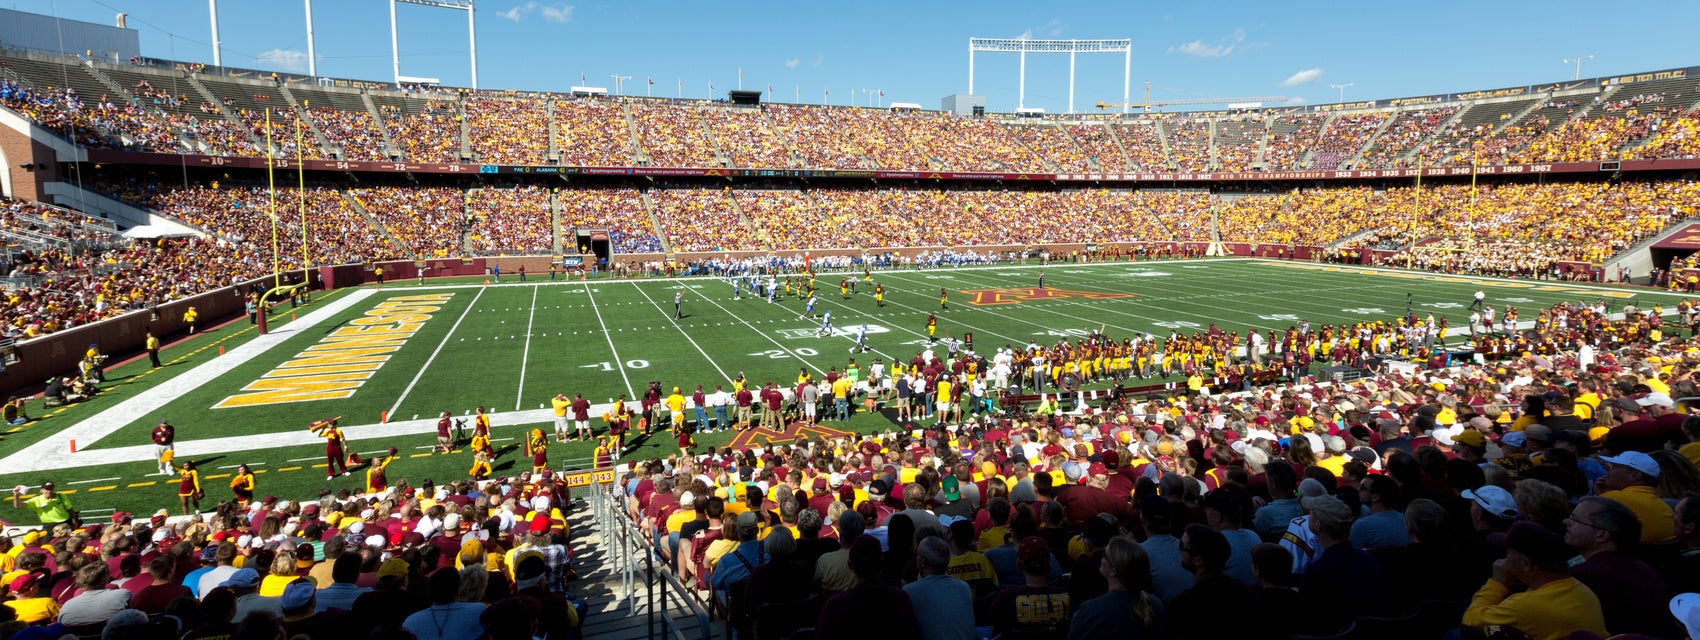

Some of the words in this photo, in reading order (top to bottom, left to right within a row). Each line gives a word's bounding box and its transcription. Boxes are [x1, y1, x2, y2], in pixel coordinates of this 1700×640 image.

[1636, 74, 1653, 82] TEN
[211, 157, 224, 165] 10
[276, 159, 288, 168] 15
[394, 163, 406, 171] 72
[1502, 165, 1523, 173] 1960
[1530, 164, 1552, 172] 1967
[209, 292, 456, 409] MINNESOTA
[763, 347, 819, 359] 20
[599, 359, 650, 372] 10
[568, 476, 584, 484] 144
[596, 472, 612, 481] 143
[946, 562, 982, 575] GOPHERS
